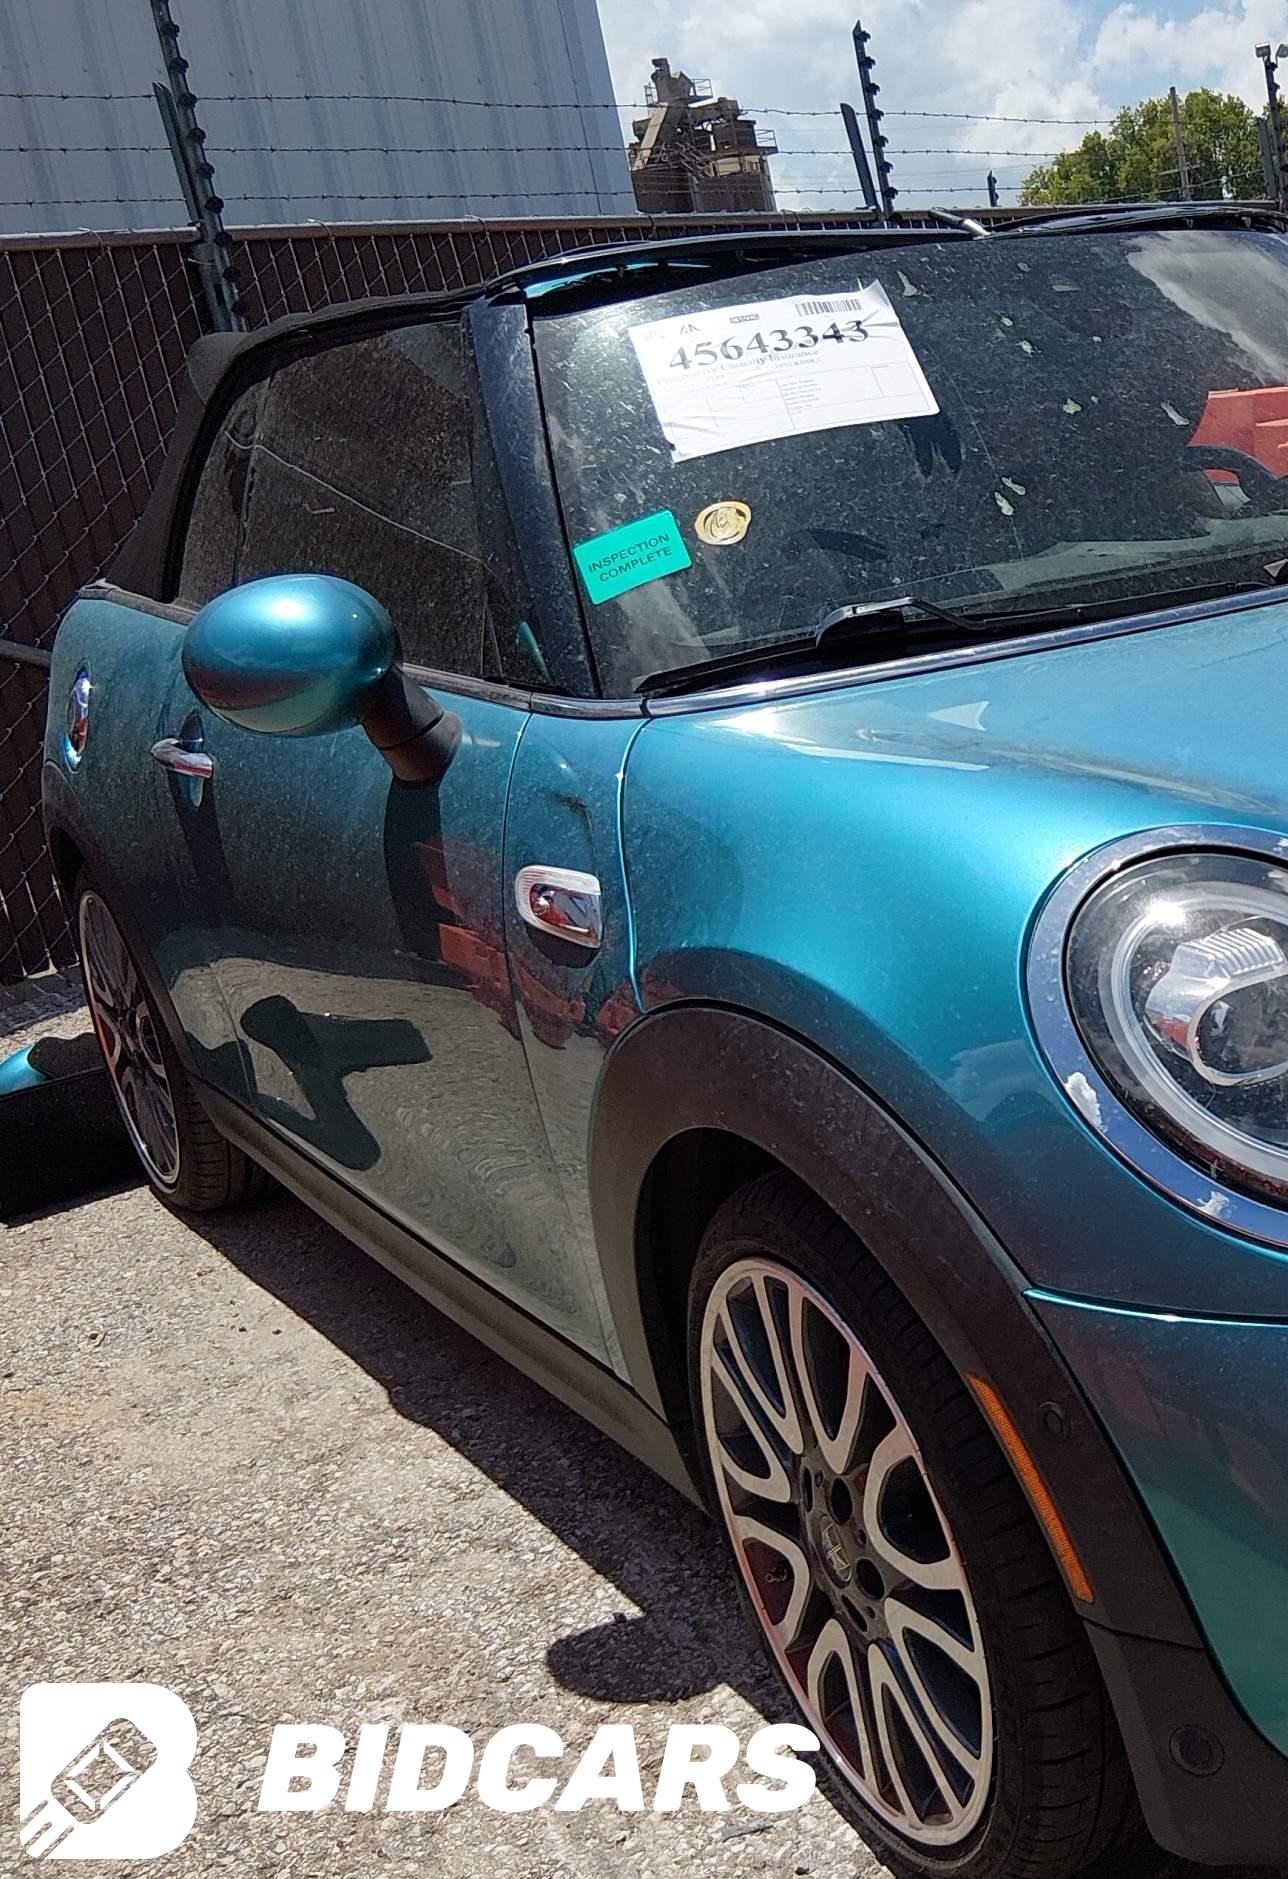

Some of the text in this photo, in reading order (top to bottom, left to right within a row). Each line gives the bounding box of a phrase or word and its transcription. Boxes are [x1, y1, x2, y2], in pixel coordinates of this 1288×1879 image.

[669, 319, 870, 370] 45643343
[588, 533, 670, 573] INSPECTION
[599, 546, 673, 582] COMPLETE
